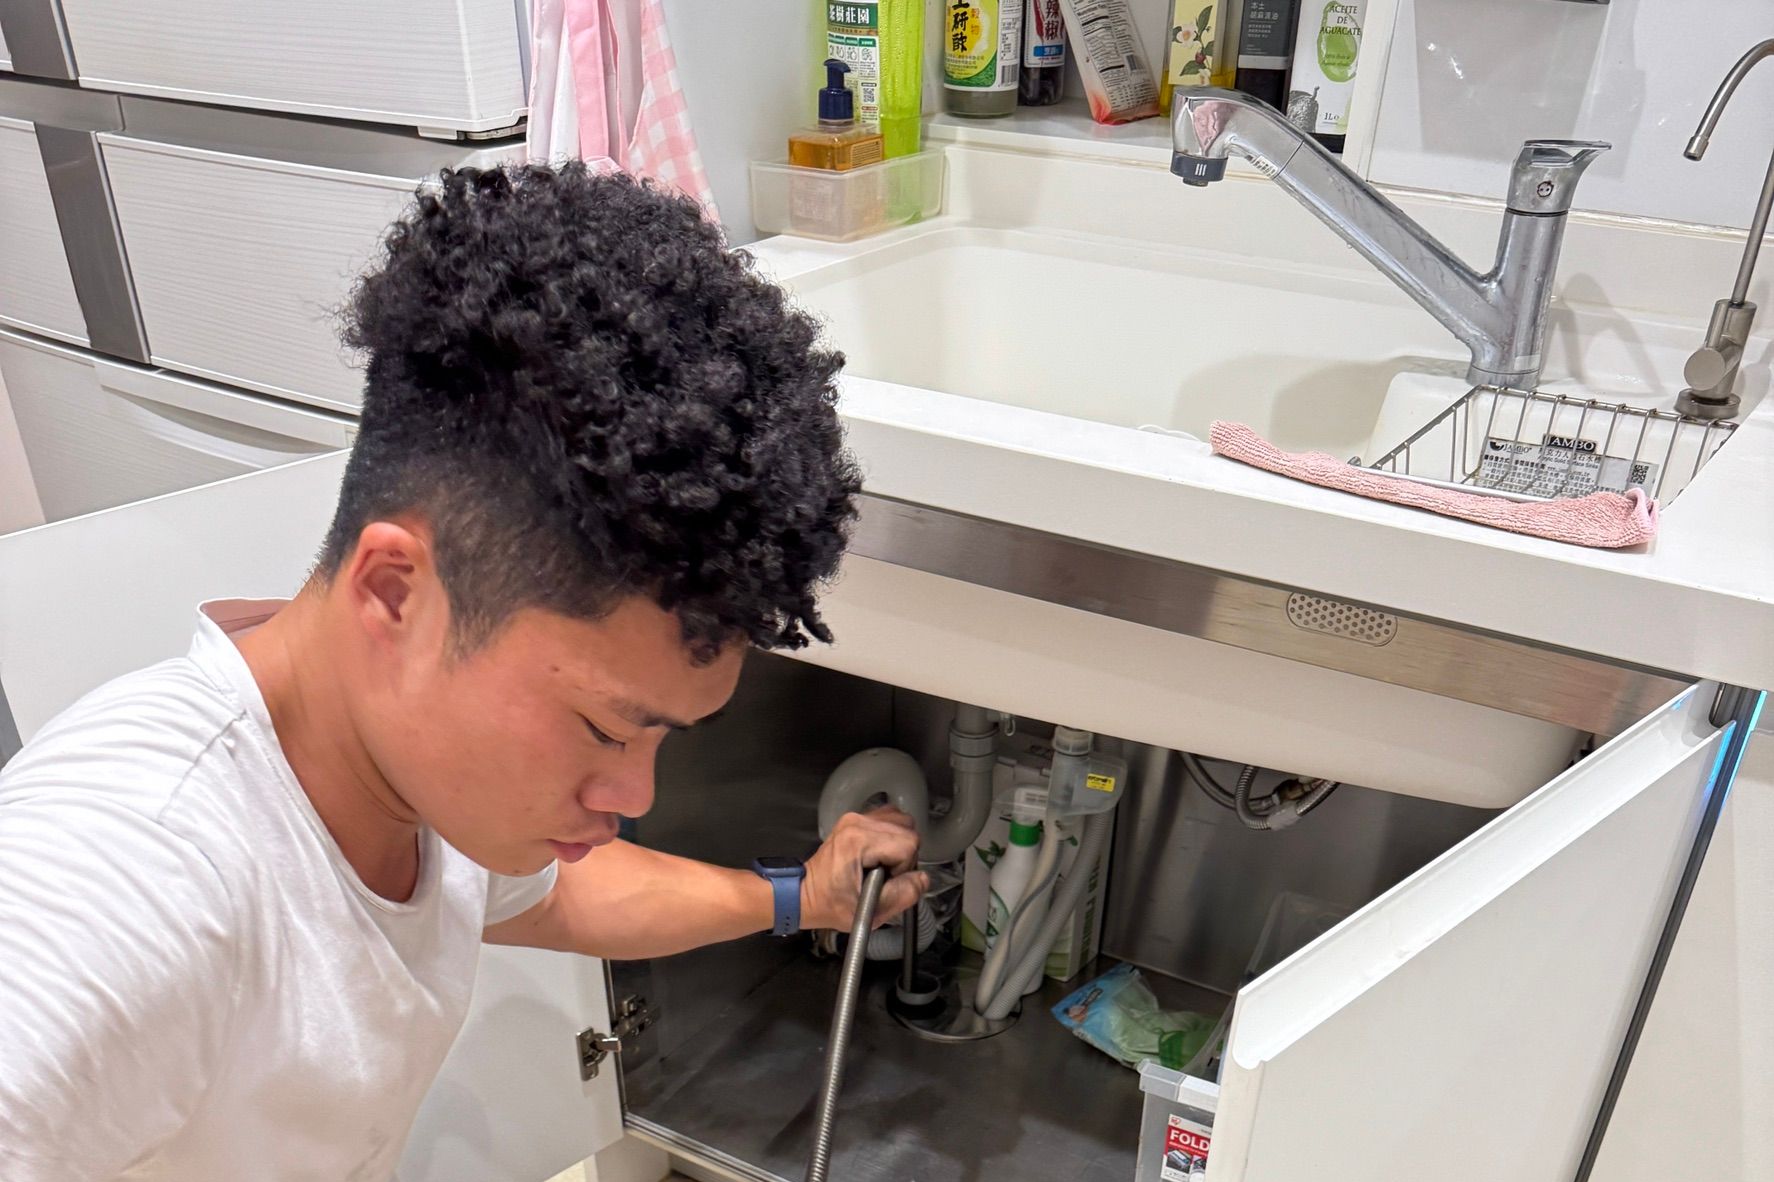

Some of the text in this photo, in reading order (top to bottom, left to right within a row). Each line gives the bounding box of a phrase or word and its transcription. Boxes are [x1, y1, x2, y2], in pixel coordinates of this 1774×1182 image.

[1329, 5, 1358, 14] ACEITE
[1337, 16, 1348, 24] DE
[1320, 26, 1361, 36] AGUACATE
[1169, 1129, 1210, 1151] FOLD
